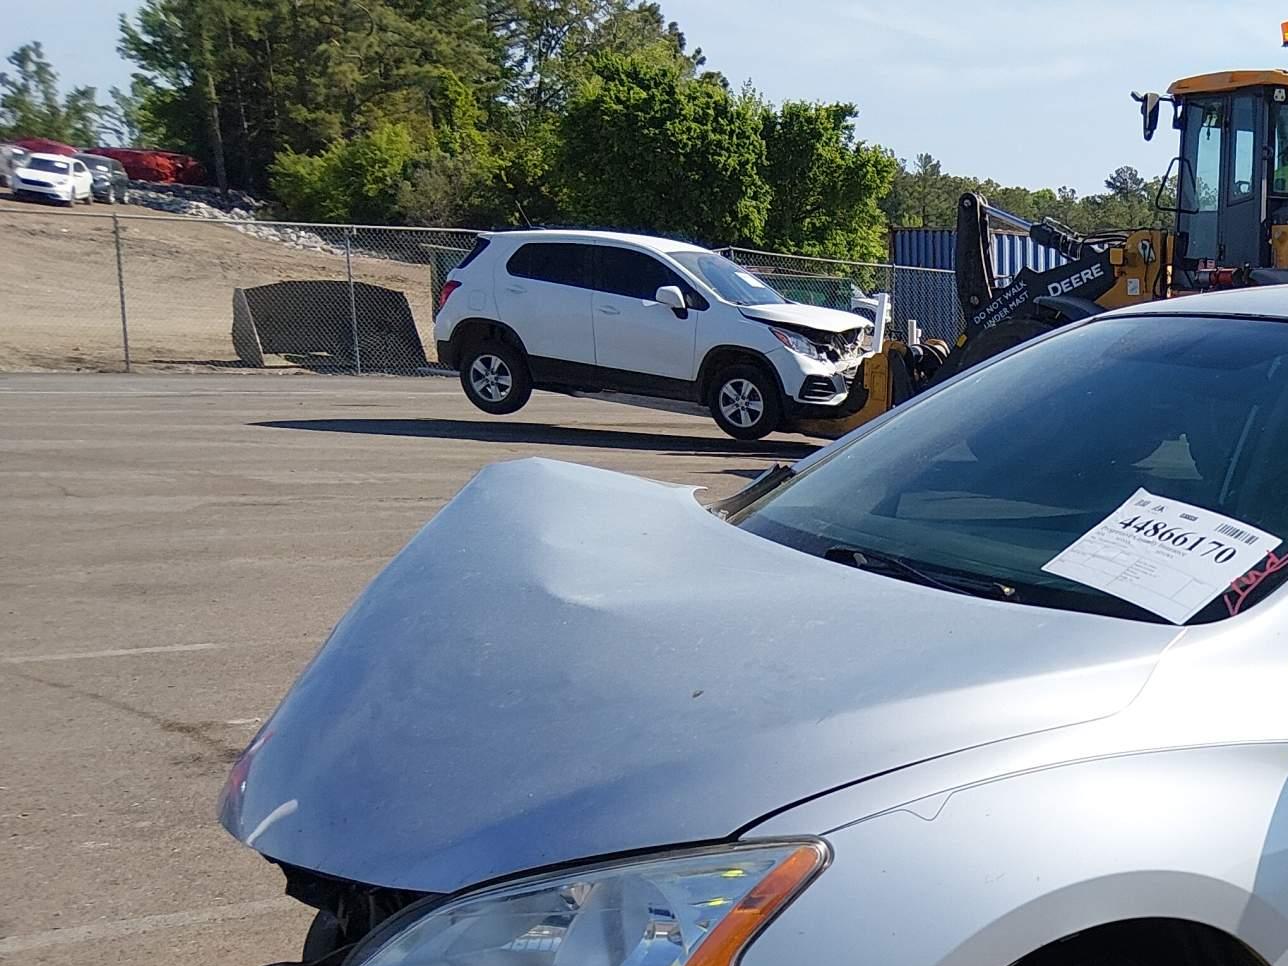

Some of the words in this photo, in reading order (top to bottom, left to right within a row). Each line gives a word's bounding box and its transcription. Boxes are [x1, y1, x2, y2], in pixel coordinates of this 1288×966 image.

[1047, 263, 1105, 297] DEERE
[973, 311, 986, 325] DO
[986, 298, 1004, 314] NOT
[1003, 280, 1028, 300] WALK
[983, 308, 1010, 330] UNDER
[1008, 290, 1030, 311] MAST
[1119, 515, 1237, 564] 44866170
